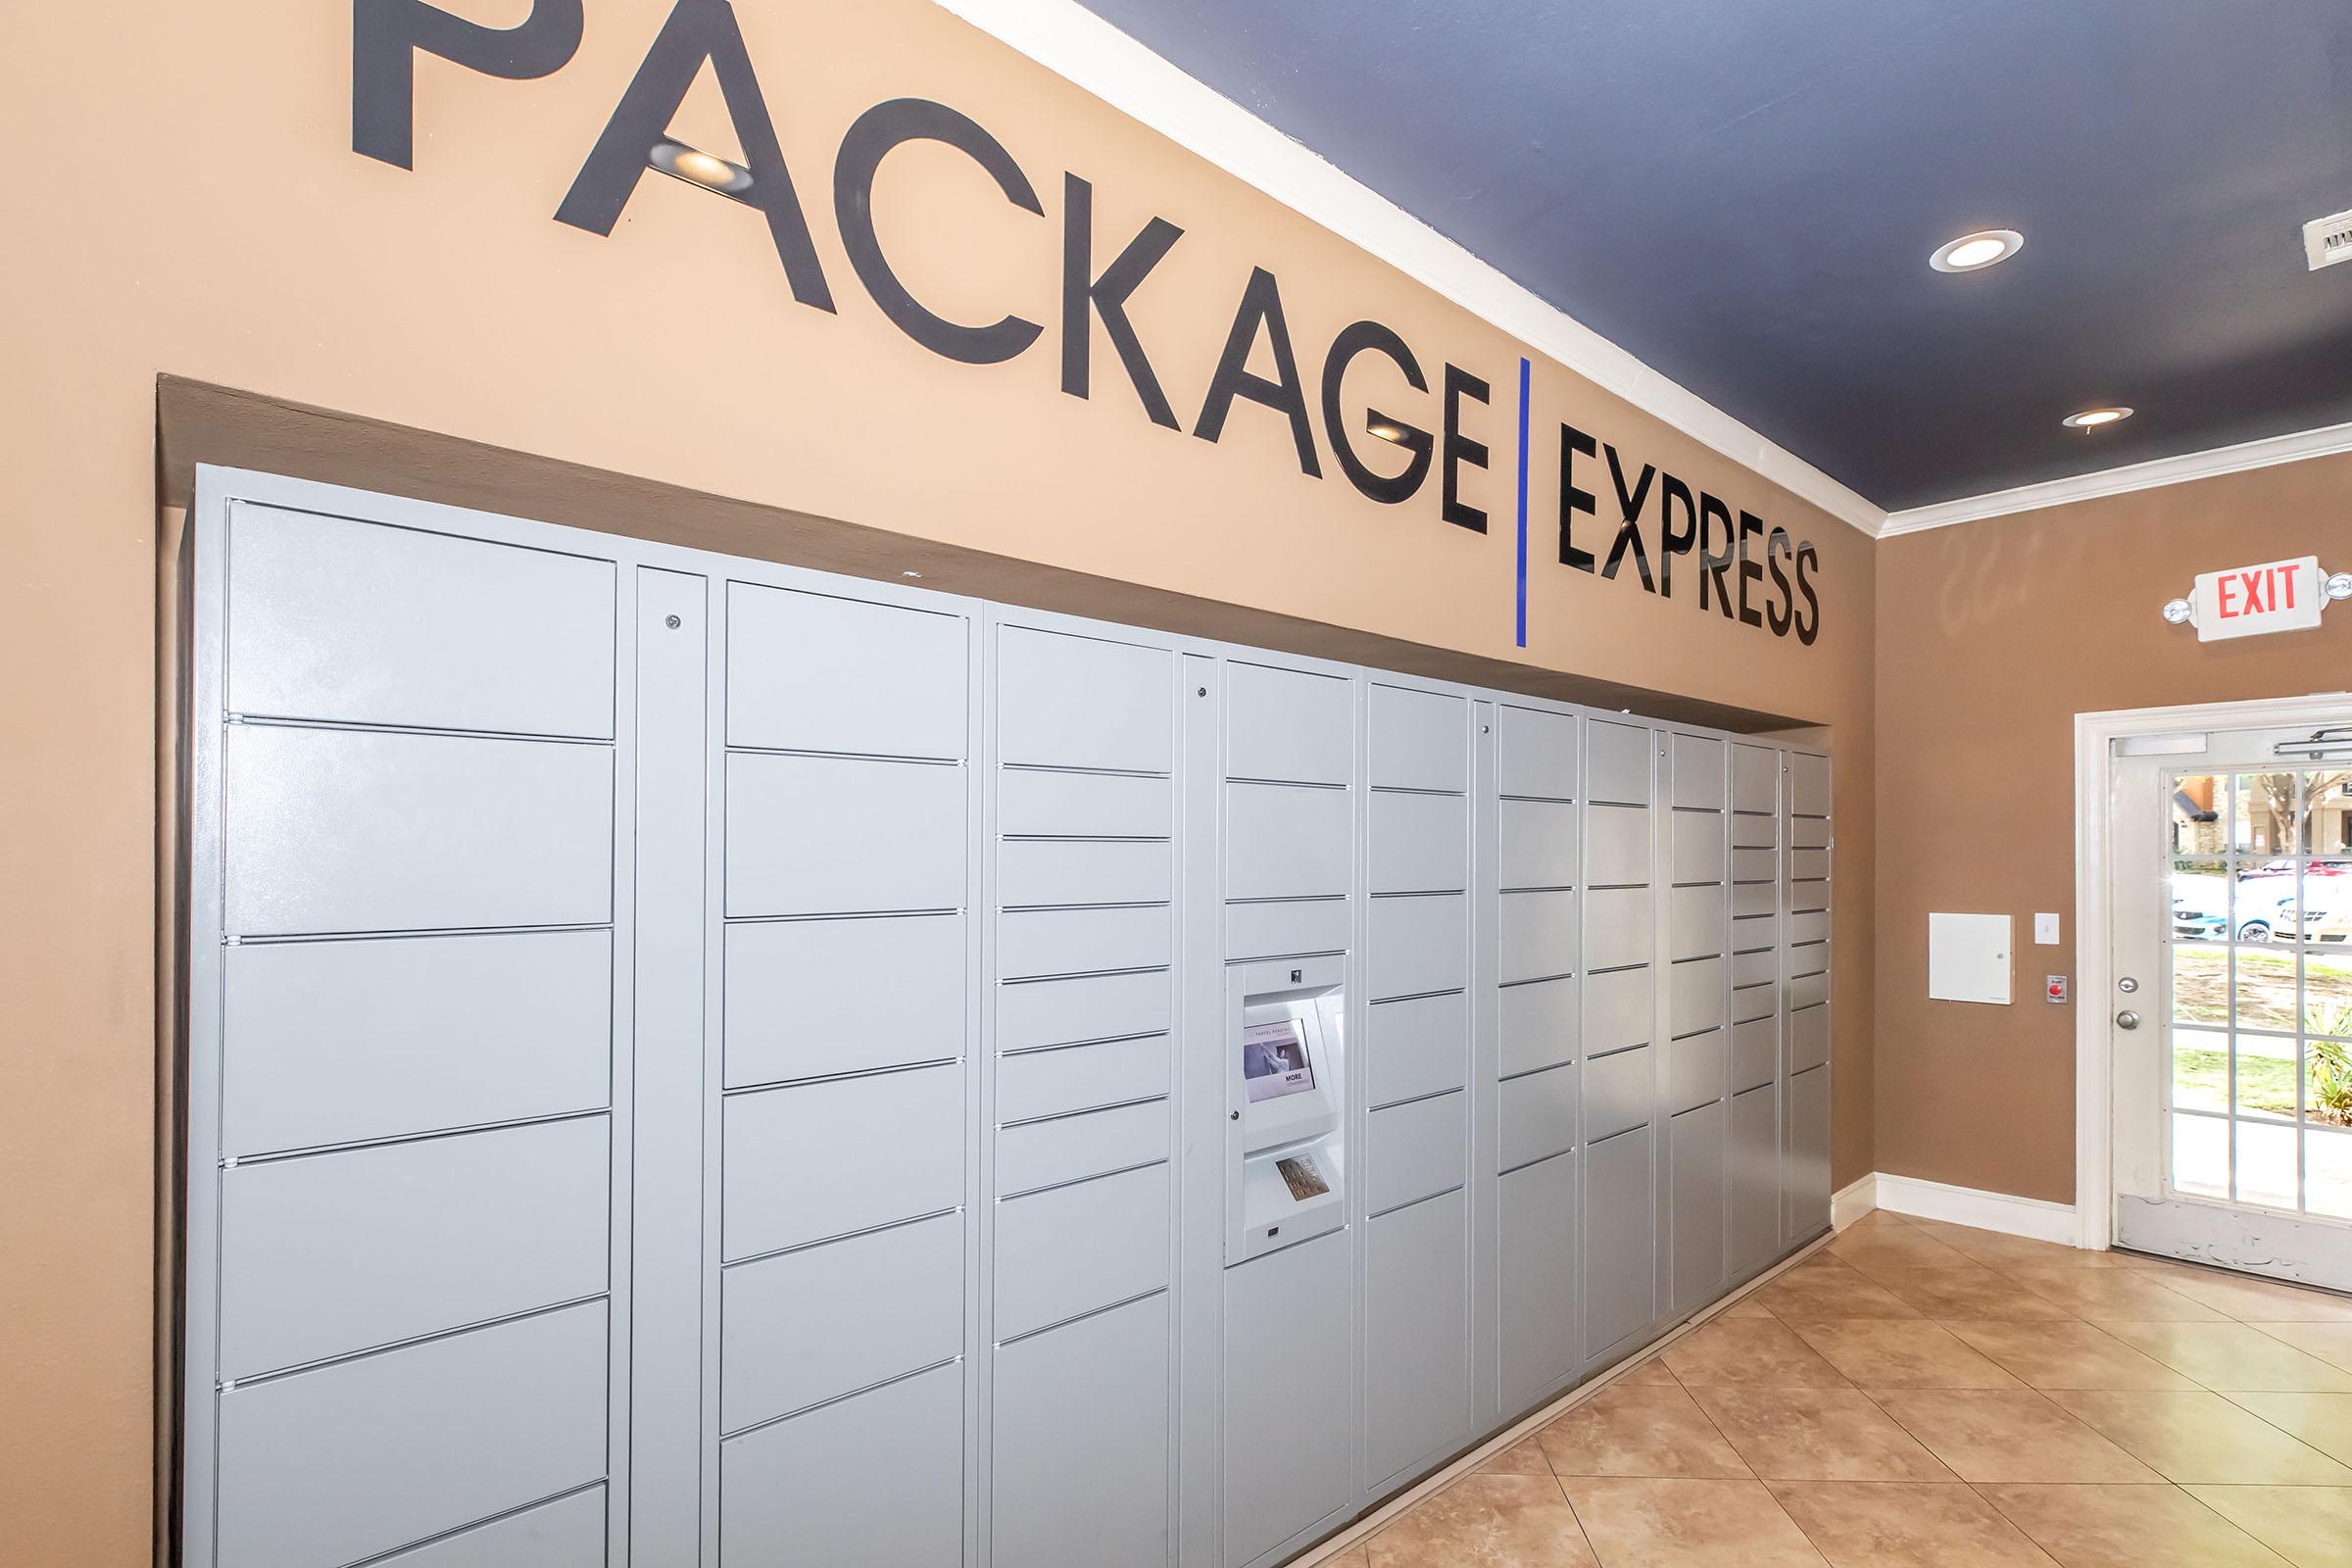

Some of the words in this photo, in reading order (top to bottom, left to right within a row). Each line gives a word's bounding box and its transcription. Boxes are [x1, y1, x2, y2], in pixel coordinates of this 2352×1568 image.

[1558, 422, 1820, 647] EXPRESS
[2218, 564, 2300, 619] EXIT
[1285, 1072, 1302, 1082] MORE
